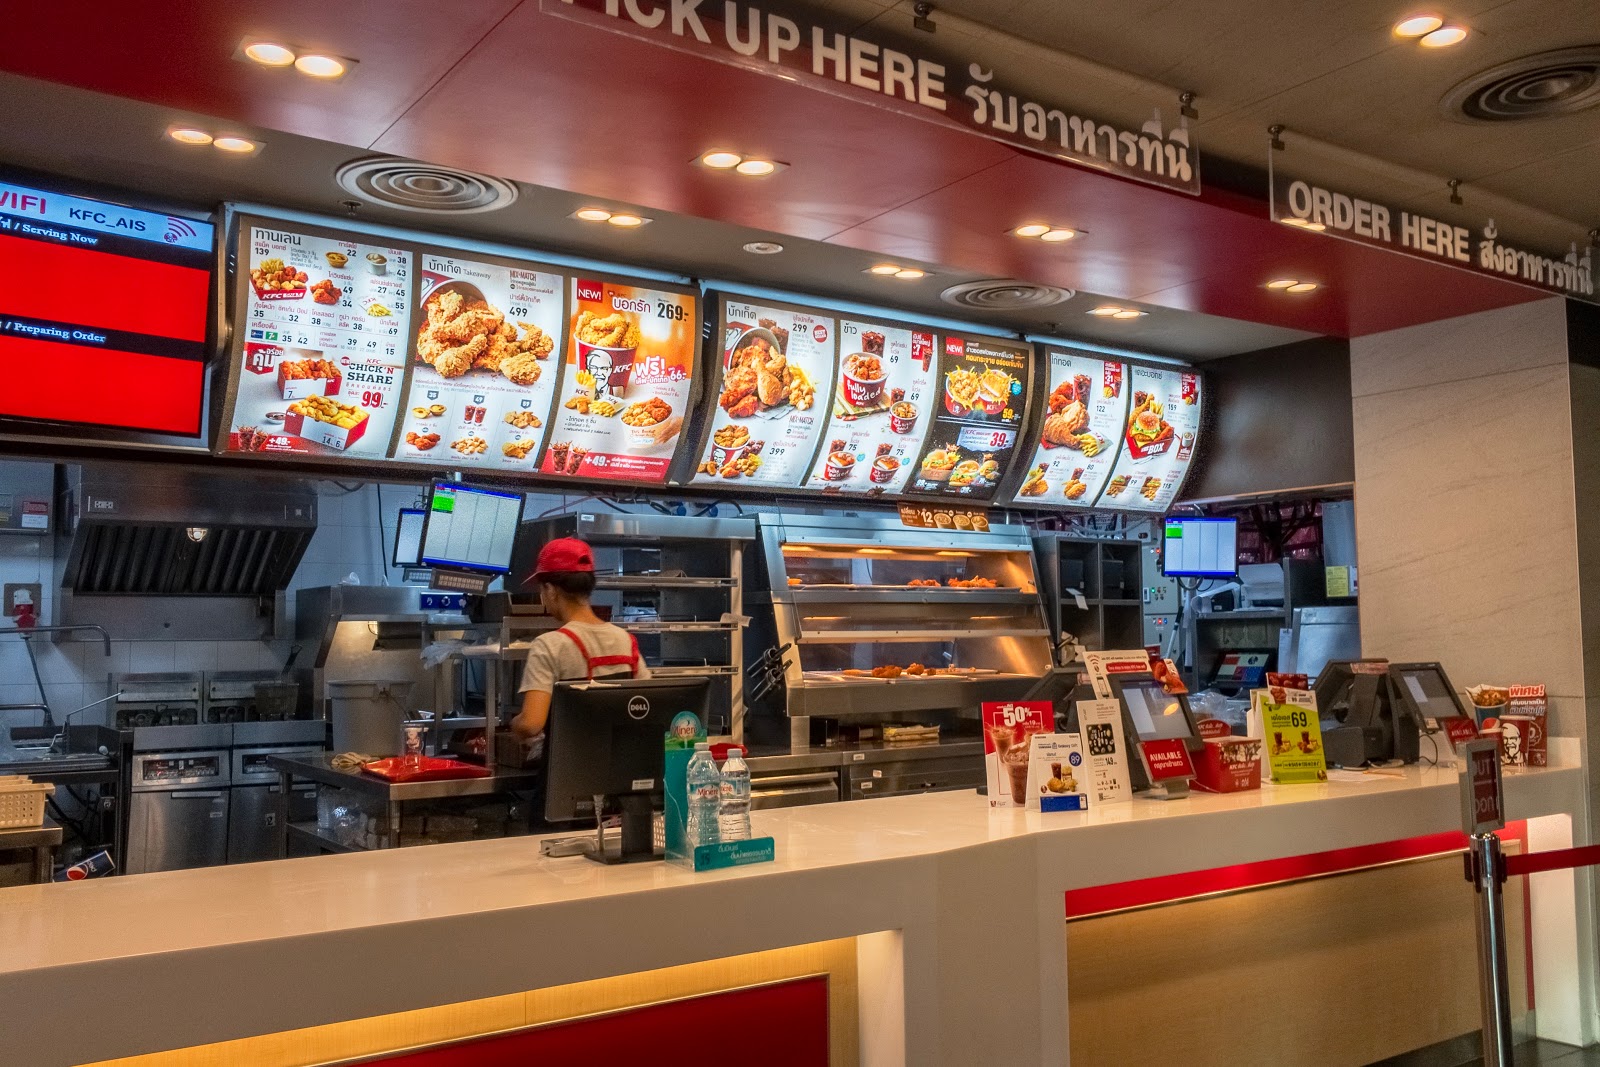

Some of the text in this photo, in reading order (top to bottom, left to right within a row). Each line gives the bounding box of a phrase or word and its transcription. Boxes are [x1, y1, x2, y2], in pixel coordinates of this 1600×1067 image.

[724, 1, 800, 63] UP
[812, 26, 946, 111] HERE
[964, 62, 1193, 182] รับอาหารที่นี่
[69, 207, 146, 232] KFC_AIS
[1288, 180, 1471, 263] ORDER HERE
[22, 224, 68, 241] Serving
[70, 232, 98, 245] Now
[255, 247, 270, 256] 139
[346, 249, 357, 258] 22
[1479, 217, 1594, 296] สั่งอาหารที่นี่
[397, 256, 407, 265] 38
[396, 269, 407, 277] 43
[428, 259, 491, 280] บักเก็ต Takeaway
[342, 285, 354, 294] 49
[377, 286, 387, 294] 27
[395, 288, 406, 297] 45
[578, 289, 602, 300] NEW!
[342, 299, 353, 308] 34
[395, 302, 405, 310] 55
[612, 297, 651, 314] บอกรัก
[253, 309, 265, 318] 35
[509, 306, 527, 317] 499
[728, 305, 757, 320] บักเก็ต
[288, 314, 299, 322] 32
[311, 317, 321, 325] 38
[352, 323, 363, 331] 38
[792, 323, 808, 333] 299
[843, 323, 858, 335] ข้าว
[13, 322, 70, 340] Preparing
[72, 330, 106, 343] Order
[282, 334, 292, 343] 35
[297, 337, 308, 345] 42
[347, 338, 357, 346] 39
[385, 348, 395, 356] 15
[946, 344, 963, 354] NEW!
[890, 355, 899, 363] 69
[1051, 354, 1072, 367] ไก่ทอด
[613, 363, 633, 374] KFC
[635, 356, 665, 376] ฟรี!
[347, 372, 393, 385] SHARE
[575, 388, 589, 396] KFC
[847, 379, 866, 396] fully
[288, 390, 293, 398] 7
[851, 386, 880, 401] loaded
[911, 392, 919, 400] 69
[323, 436, 331, 444] 14
[1148, 443, 1164, 454] BOX
[585, 456, 610, 467] +49.-
[921, 511, 933, 523] 12
[1510, 685, 1544, 697] พิเศษ!
[630, 703, 647, 711] DELL
[1003, 706, 1032, 727] 50%
[1291, 712, 1307, 727] 69
[1070, 755, 1080, 764] 89
[1105, 757, 1113, 765] 149
[1150, 751, 1182, 762] AVAILABLE
[1477, 759, 1490, 775] UT
